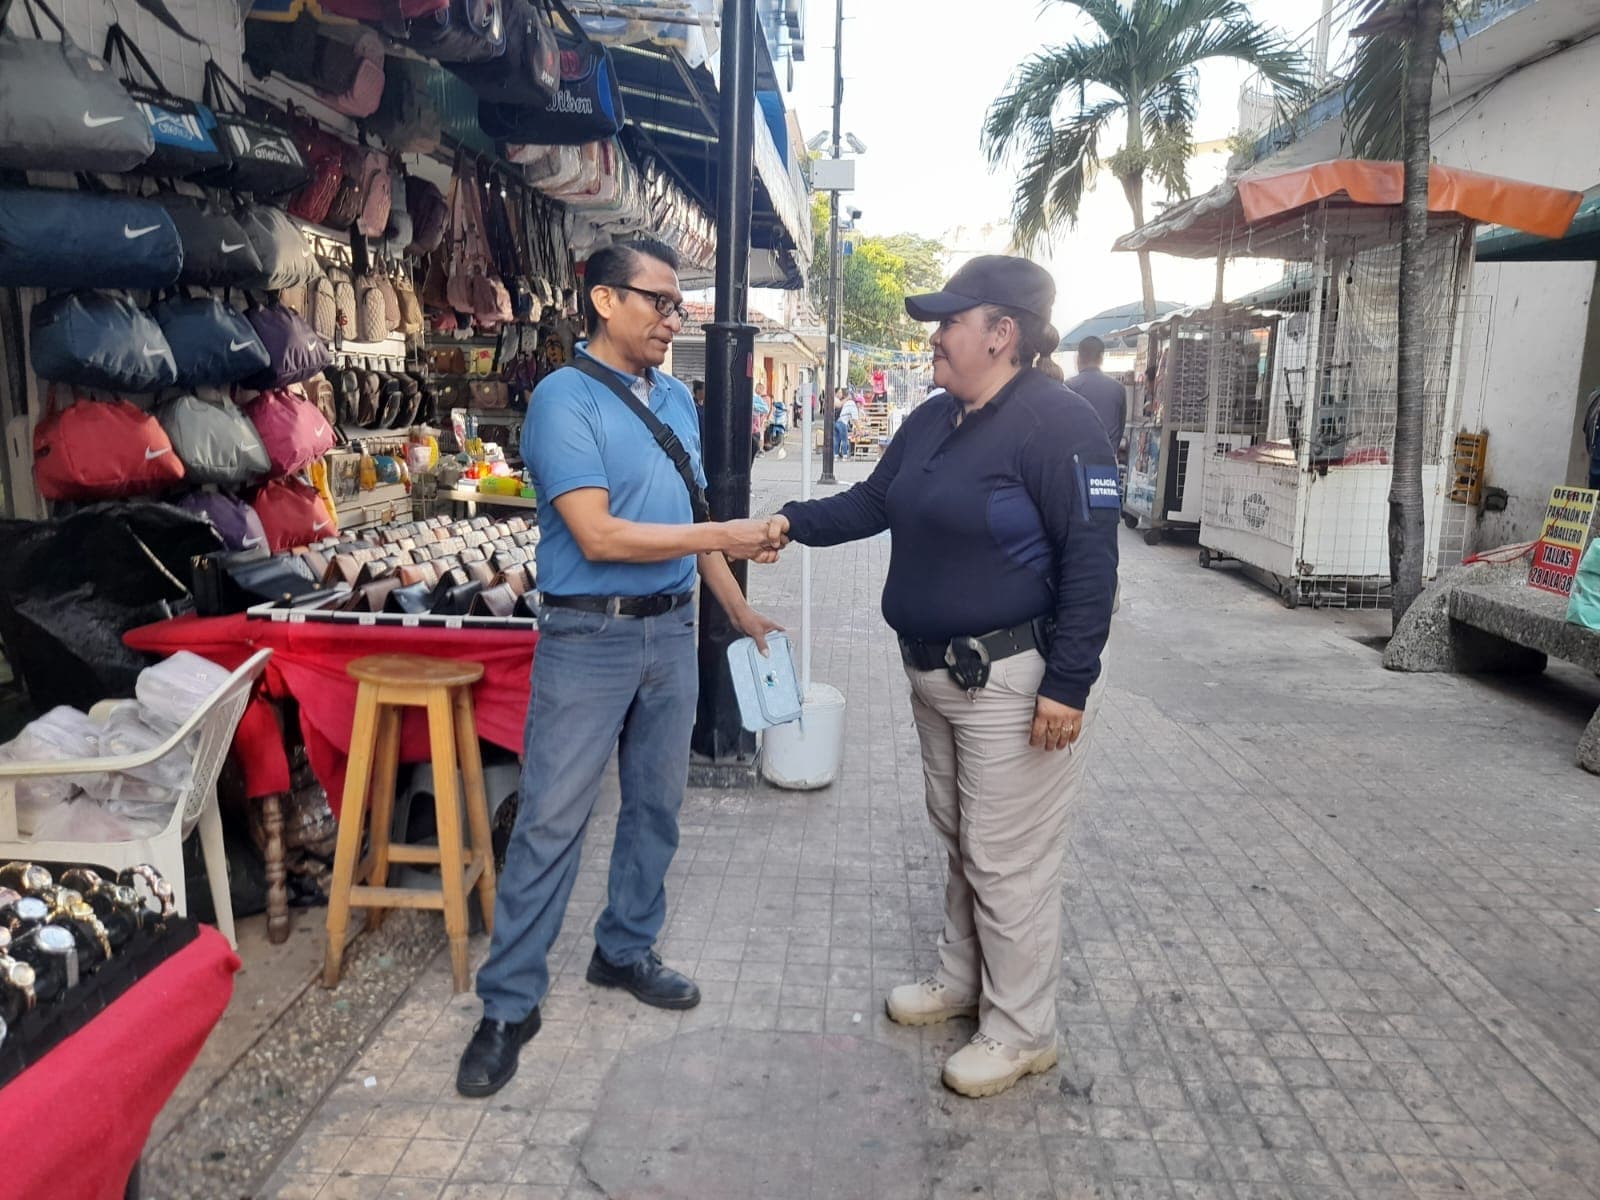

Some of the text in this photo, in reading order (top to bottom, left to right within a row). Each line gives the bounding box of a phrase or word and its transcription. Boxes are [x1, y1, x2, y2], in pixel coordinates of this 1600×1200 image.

[546, 89, 593, 114] Wilson
[1090, 478, 1117, 487] POLICÍA
[1554, 488, 1594, 504] OFERTA
[1546, 504, 1591, 525] PANTALÓN DE
[1546, 524, 1582, 544] CABALLERO
[1530, 567, 1543, 584] 28
[1559, 573, 1573, 593] 38
